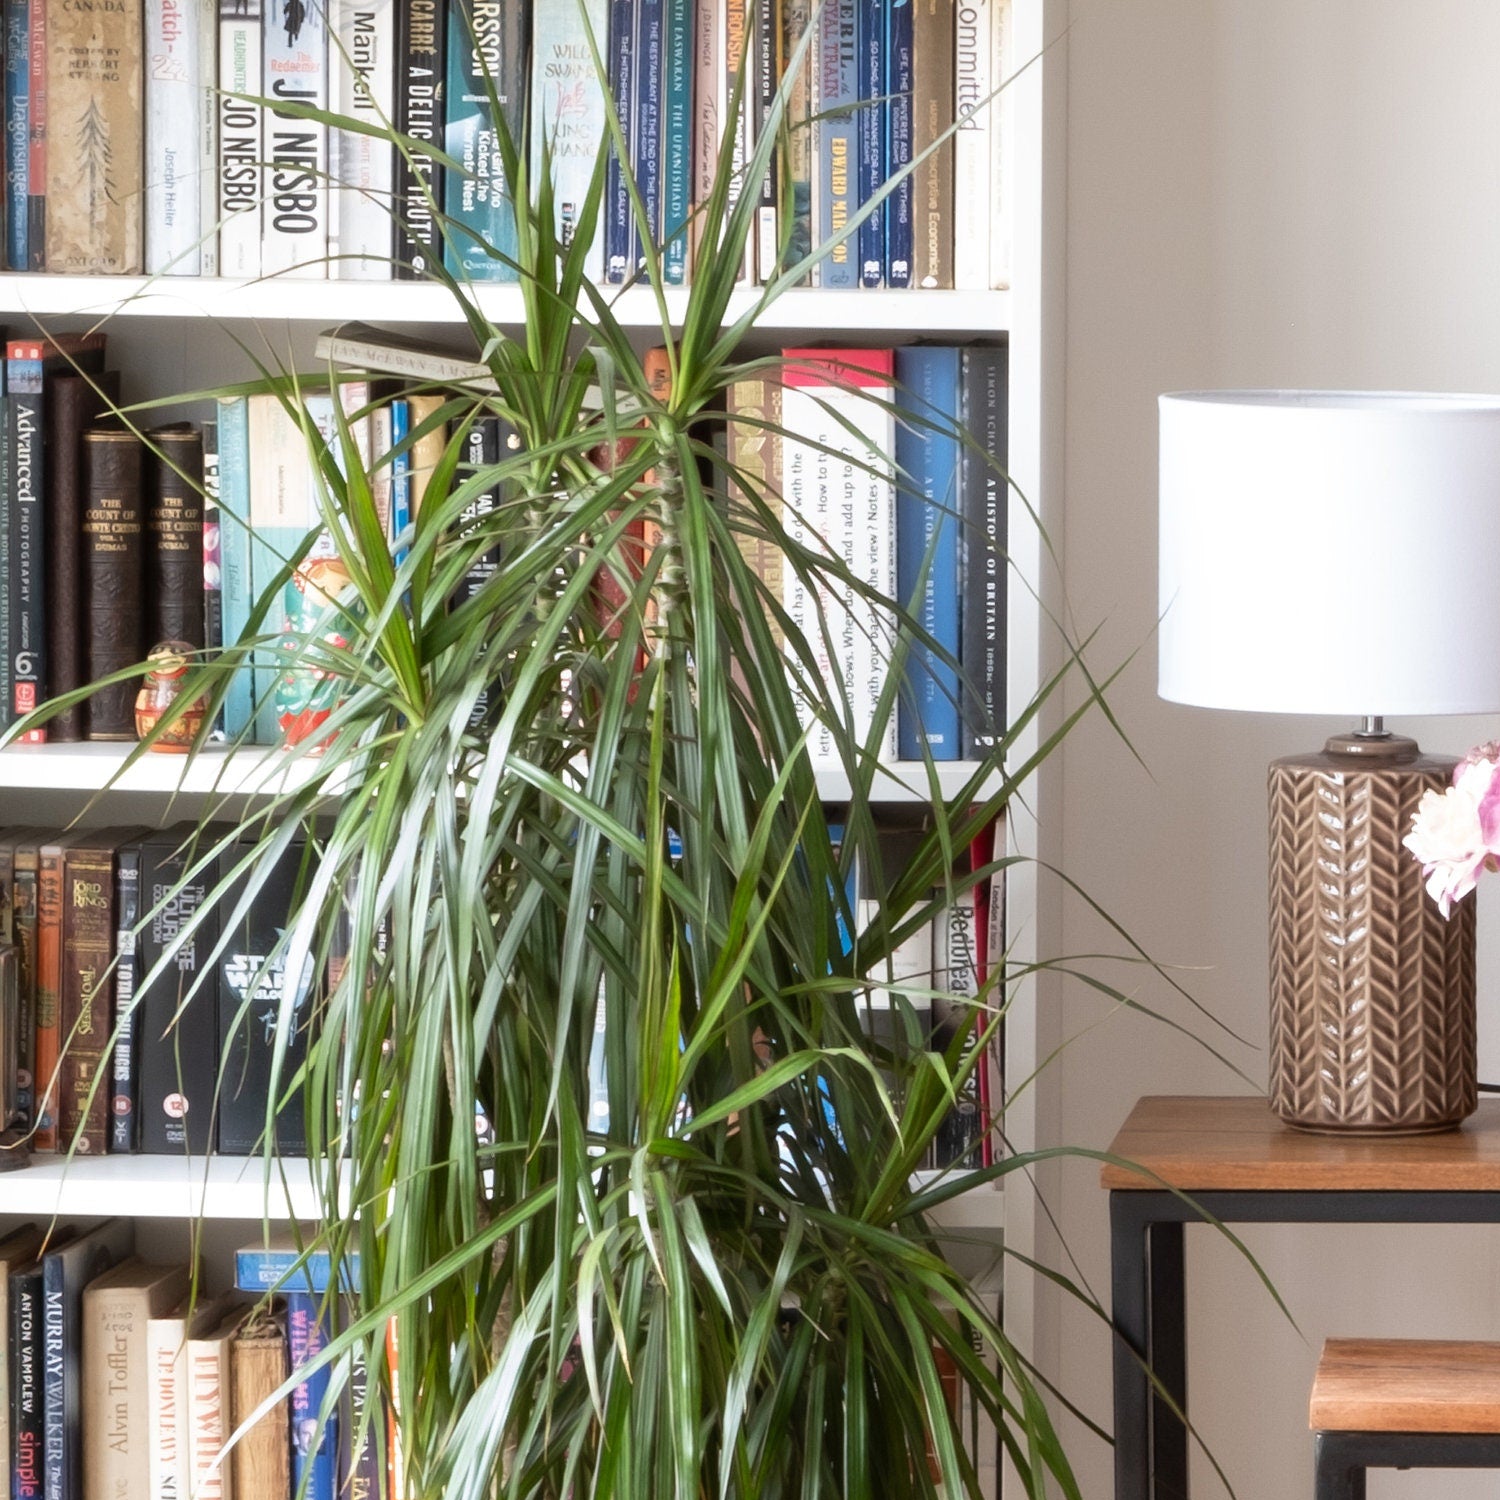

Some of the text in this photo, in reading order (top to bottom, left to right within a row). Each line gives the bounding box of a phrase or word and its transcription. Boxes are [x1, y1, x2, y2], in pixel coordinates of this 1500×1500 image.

[32, 20, 44, 76] McEwan
[471, 0, 501, 77] RSSON
[649, 21, 659, 40] THE
[233, 30, 247, 93] HEADHUNTERS
[353, 12, 376, 110] Mankell
[408, 66, 433, 78] A
[649, 41, 658, 103] RESTAURANT
[674, 27, 684, 91] EASWARAN
[762, 38, 770, 97] THOMPSON
[823, 43, 839, 99] TRAIN
[31, 121, 44, 149] Dogs
[648, 104, 657, 116] AT
[648, 117, 657, 137] THE
[222, 98, 257, 212] JO NESBO
[477, 131, 490, 178] Kicked
[647, 138, 656, 160] END
[671, 103, 683, 219] THE UPANISHADS
[830, 137, 848, 197] EDWARD
[163, 147, 178, 229] Joseph Heller
[273, 132, 318, 234] NESBO
[462, 180, 476, 212] Nest
[491, 178, 504, 209] Who
[617, 190, 627, 227] GALAXY
[927, 212, 940, 276] Economics
[792, 453, 804, 507] with the
[817, 467, 829, 512] How to
[843, 465, 854, 478] to
[844, 481, 856, 499] up
[17, 404, 37, 602] Advanced PHOTOGRAPHY
[841, 504, 854, 527] add
[866, 484, 879, 521] Notes
[866, 533, 879, 563] view
[986, 548, 996, 567] OF
[986, 572, 996, 641] BRITAIN
[866, 673, 880, 698] with
[116, 963, 134, 1011] TOTALLY
[113, 1044, 131, 1081] HICKS
[20, 1292, 33, 1413] ANTON VAMPLEW
[46, 1291, 64, 1461] MURRAY WALKER
[106, 1336, 129, 1396] Toffler
[106, 1402, 129, 1454] Alvin
[16, 1431, 40, 1498] simple
